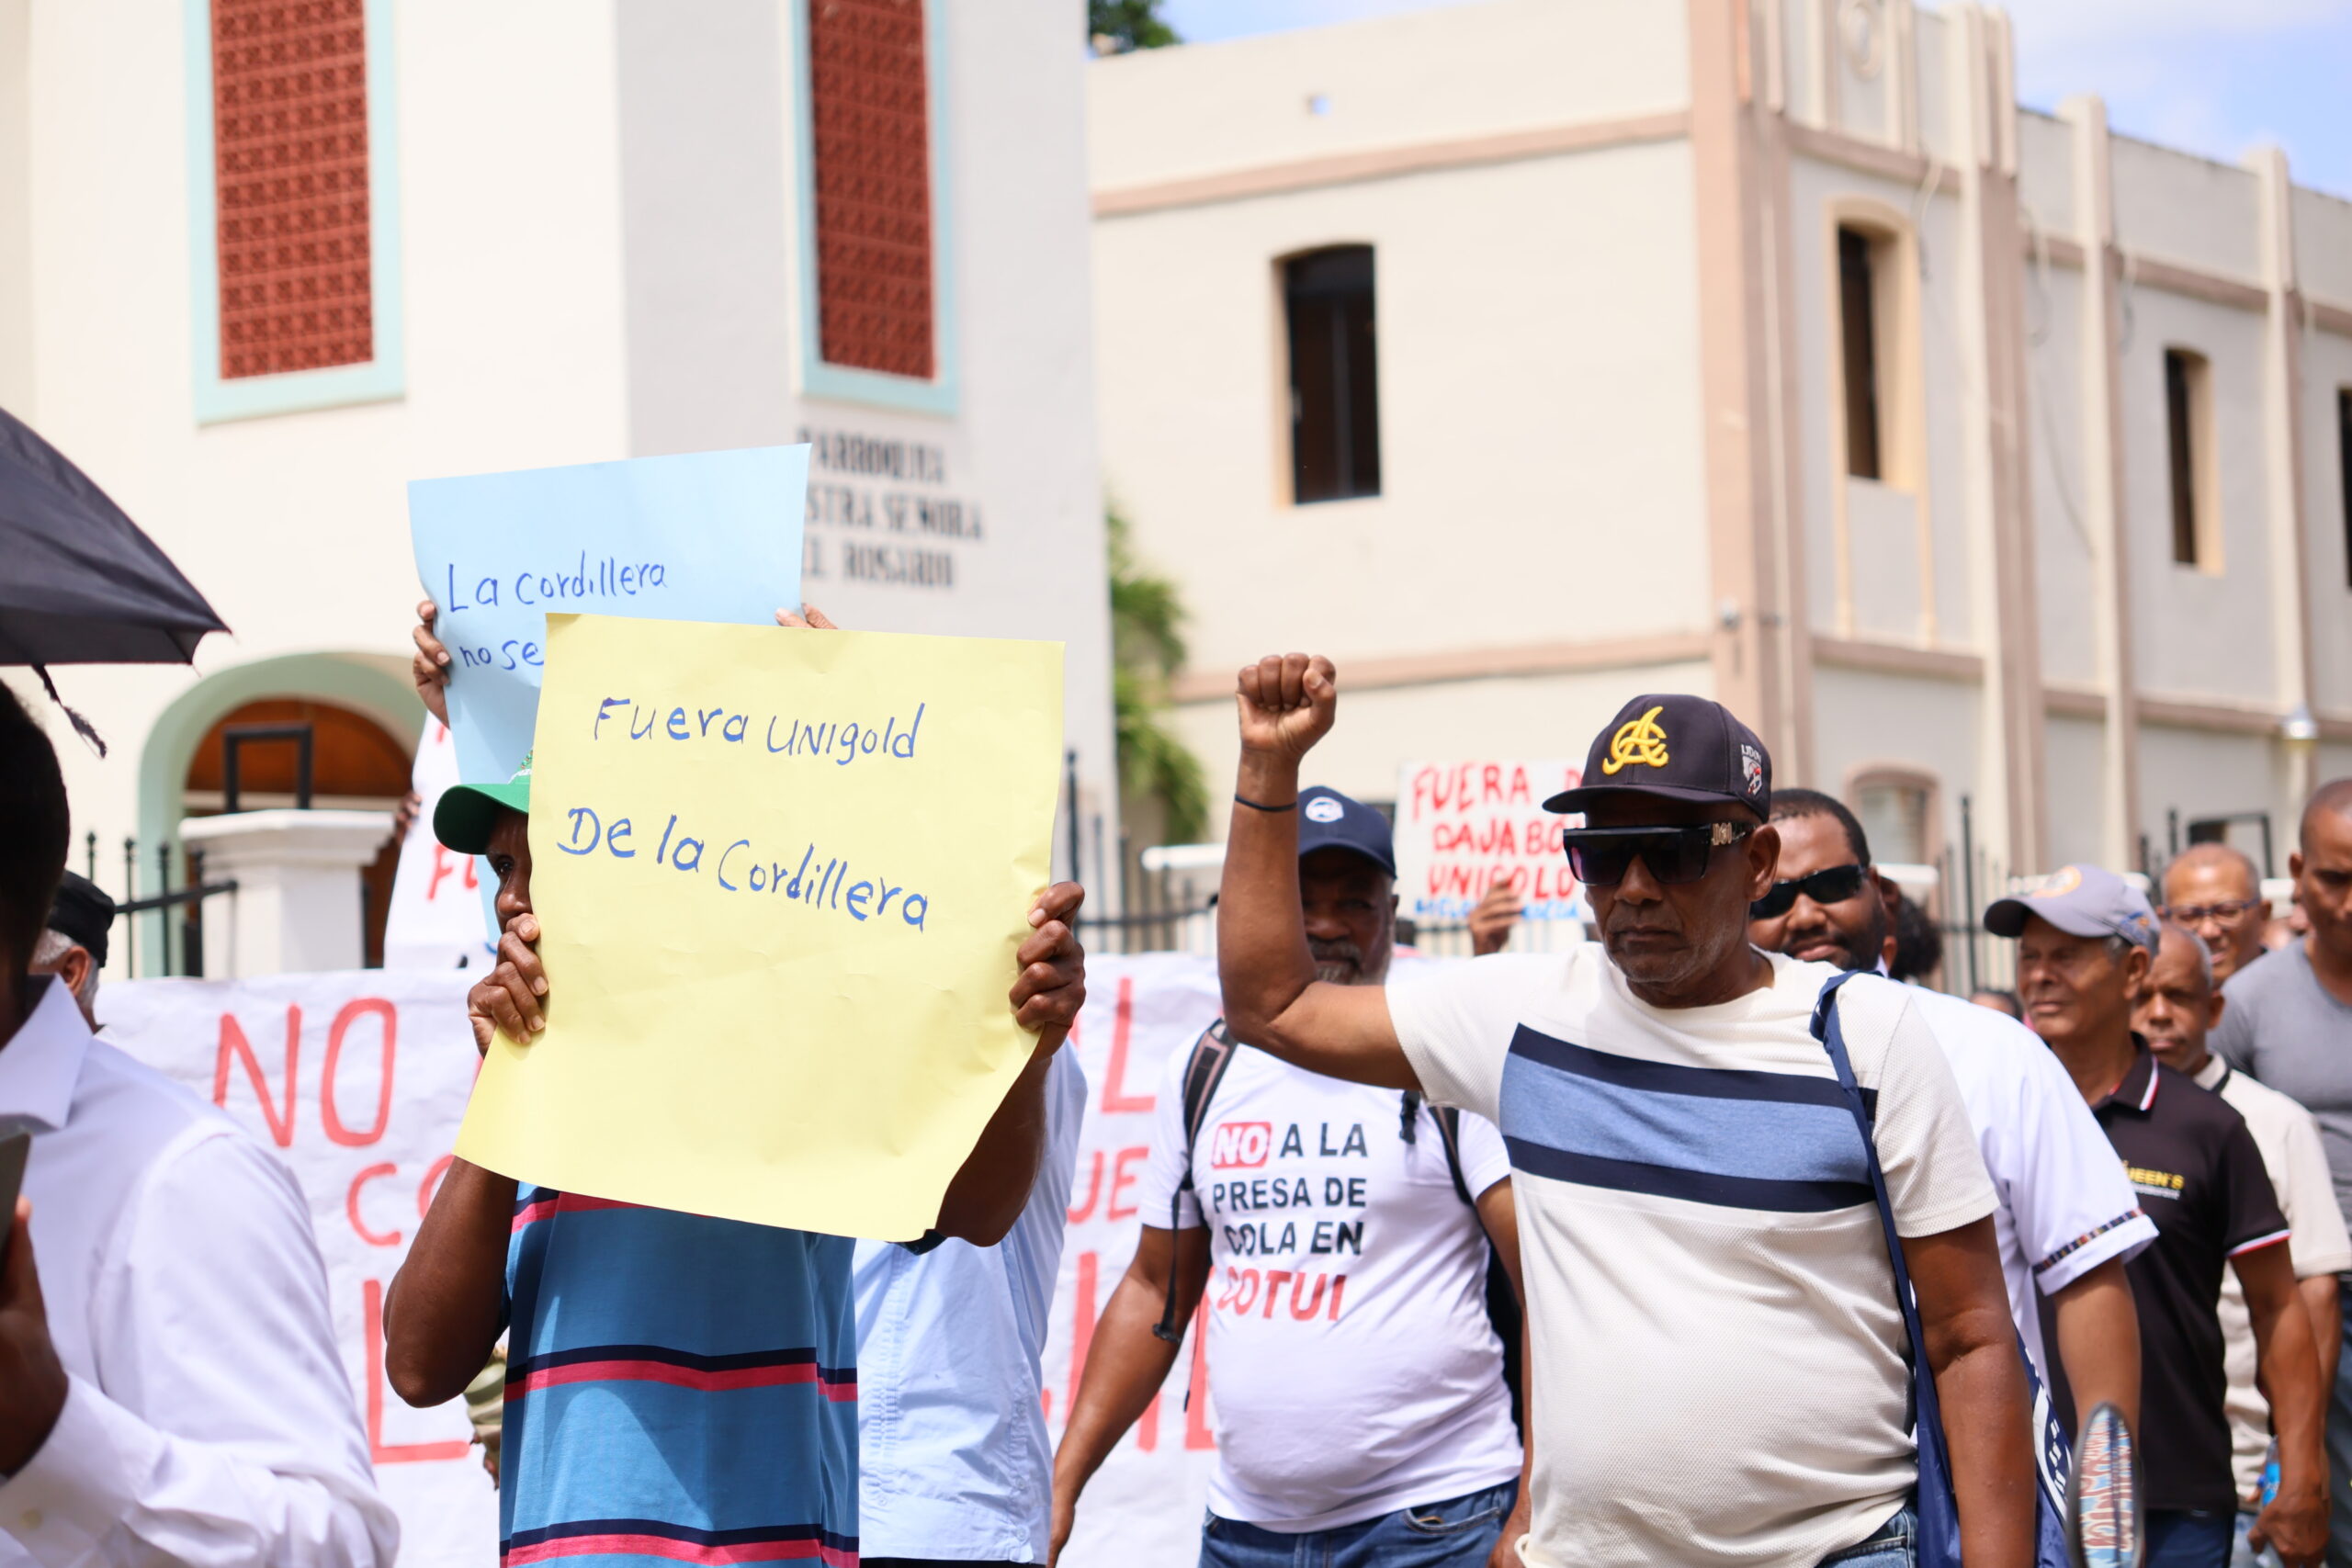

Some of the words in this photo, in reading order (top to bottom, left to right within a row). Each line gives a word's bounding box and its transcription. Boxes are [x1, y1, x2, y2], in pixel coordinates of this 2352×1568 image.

[448, 563, 498, 613] La
[459, 645, 492, 668] no
[594, 697, 749, 744] Fuera
[1413, 764, 1531, 821] FUERA
[557, 807, 636, 858] De
[656, 813, 705, 873] la
[718, 839, 928, 933] Cordillera
[214, 998, 396, 1147] NO
[1215, 1124, 1270, 1166] NO
[1280, 1123, 1304, 1157] A
[1319, 1122, 1368, 1157] LA
[1213, 1178, 1312, 1213] PRESA
[1324, 1177, 1367, 1208] DE
[1225, 1222, 1296, 1256] COLA
[1310, 1221, 1364, 1255] EN
[1216, 1266, 1348, 1321] COTUI
